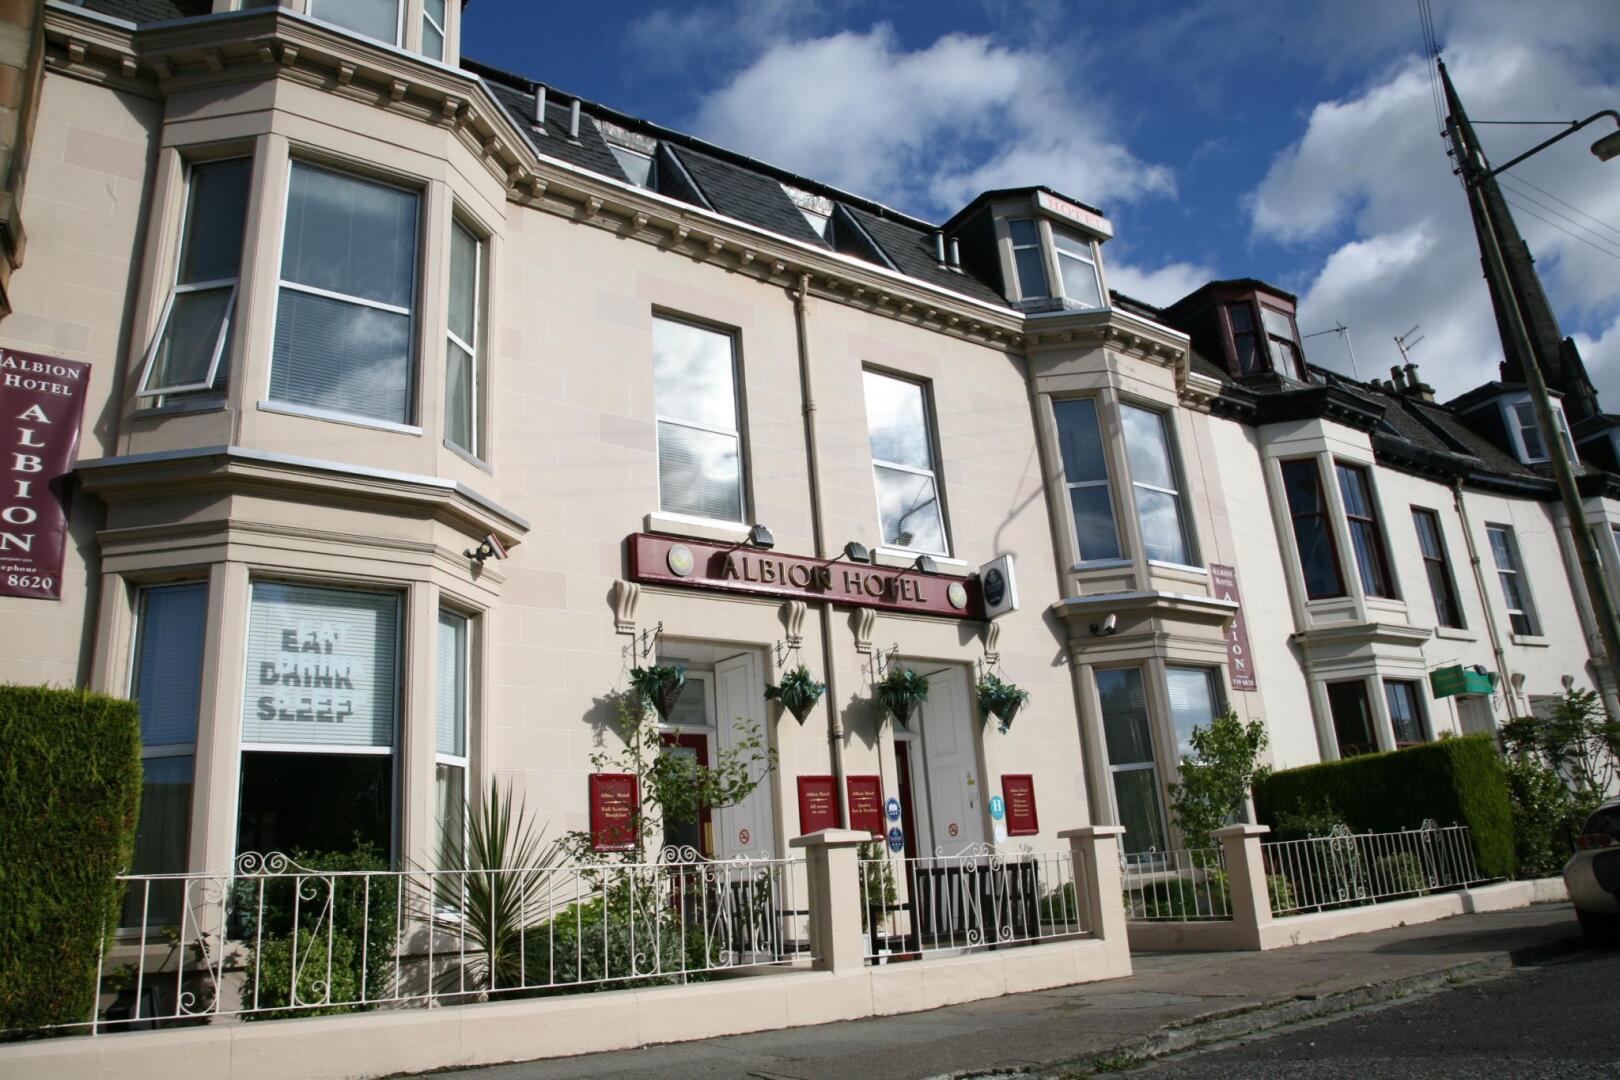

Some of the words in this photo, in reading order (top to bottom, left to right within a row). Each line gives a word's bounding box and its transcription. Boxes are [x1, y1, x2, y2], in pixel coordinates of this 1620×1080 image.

[2, 355, 81, 380] ALBION
[4, 373, 73, 396] HOTEL
[0, 404, 51, 552] ALBION
[0, 563, 37, 573] ephone
[721, 552, 832, 591] ALBION
[7, 574, 53, 590] 8620
[843, 571, 927, 603] HOTEL
